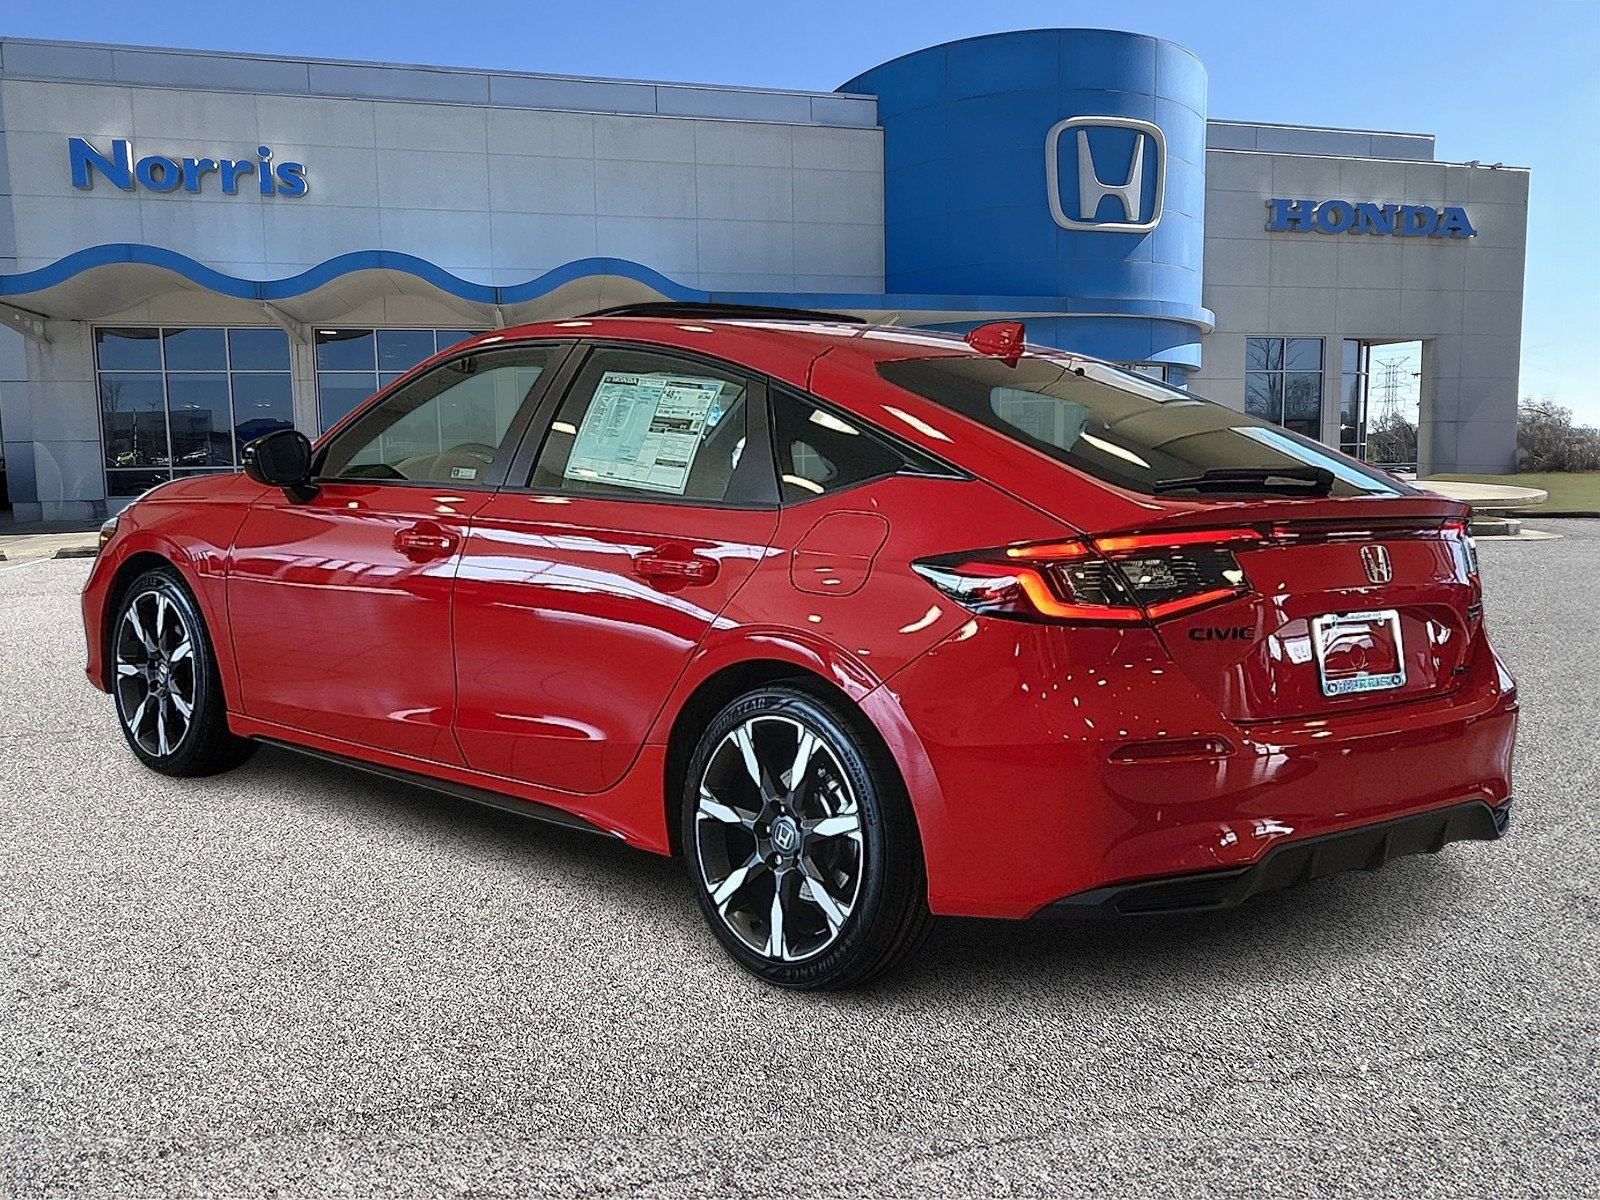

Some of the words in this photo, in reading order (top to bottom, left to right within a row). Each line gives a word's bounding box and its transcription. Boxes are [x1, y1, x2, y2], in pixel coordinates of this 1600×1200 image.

[68, 137, 309, 198] Norris
[1265, 198, 1478, 240] HONDA
[1189, 627, 1255, 641] CIVIC
